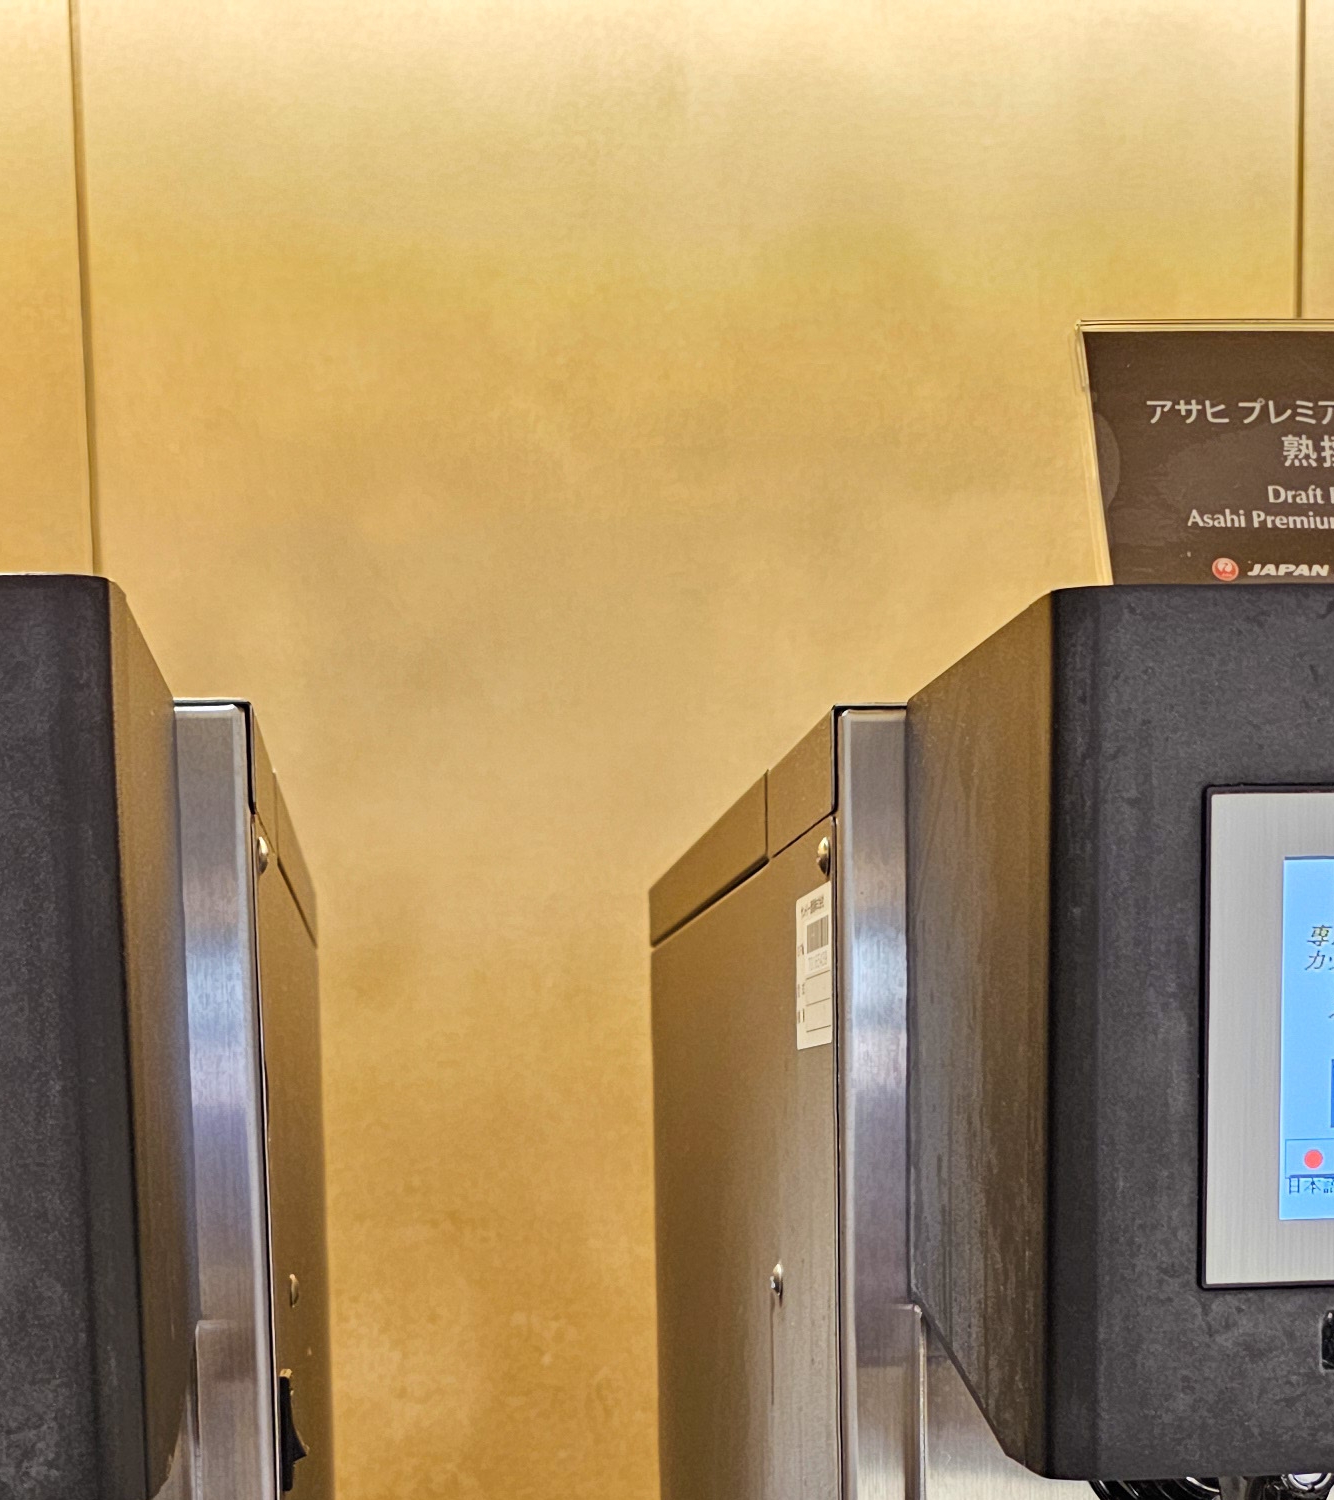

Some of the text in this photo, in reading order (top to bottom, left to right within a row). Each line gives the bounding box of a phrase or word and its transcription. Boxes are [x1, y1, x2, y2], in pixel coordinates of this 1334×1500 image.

[1146, 400, 1230, 425] アサヒ
[1267, 485, 1325, 505] Draft
[1187, 510, 1246, 529] Asahi
[1247, 563, 1330, 577] JAPAN
